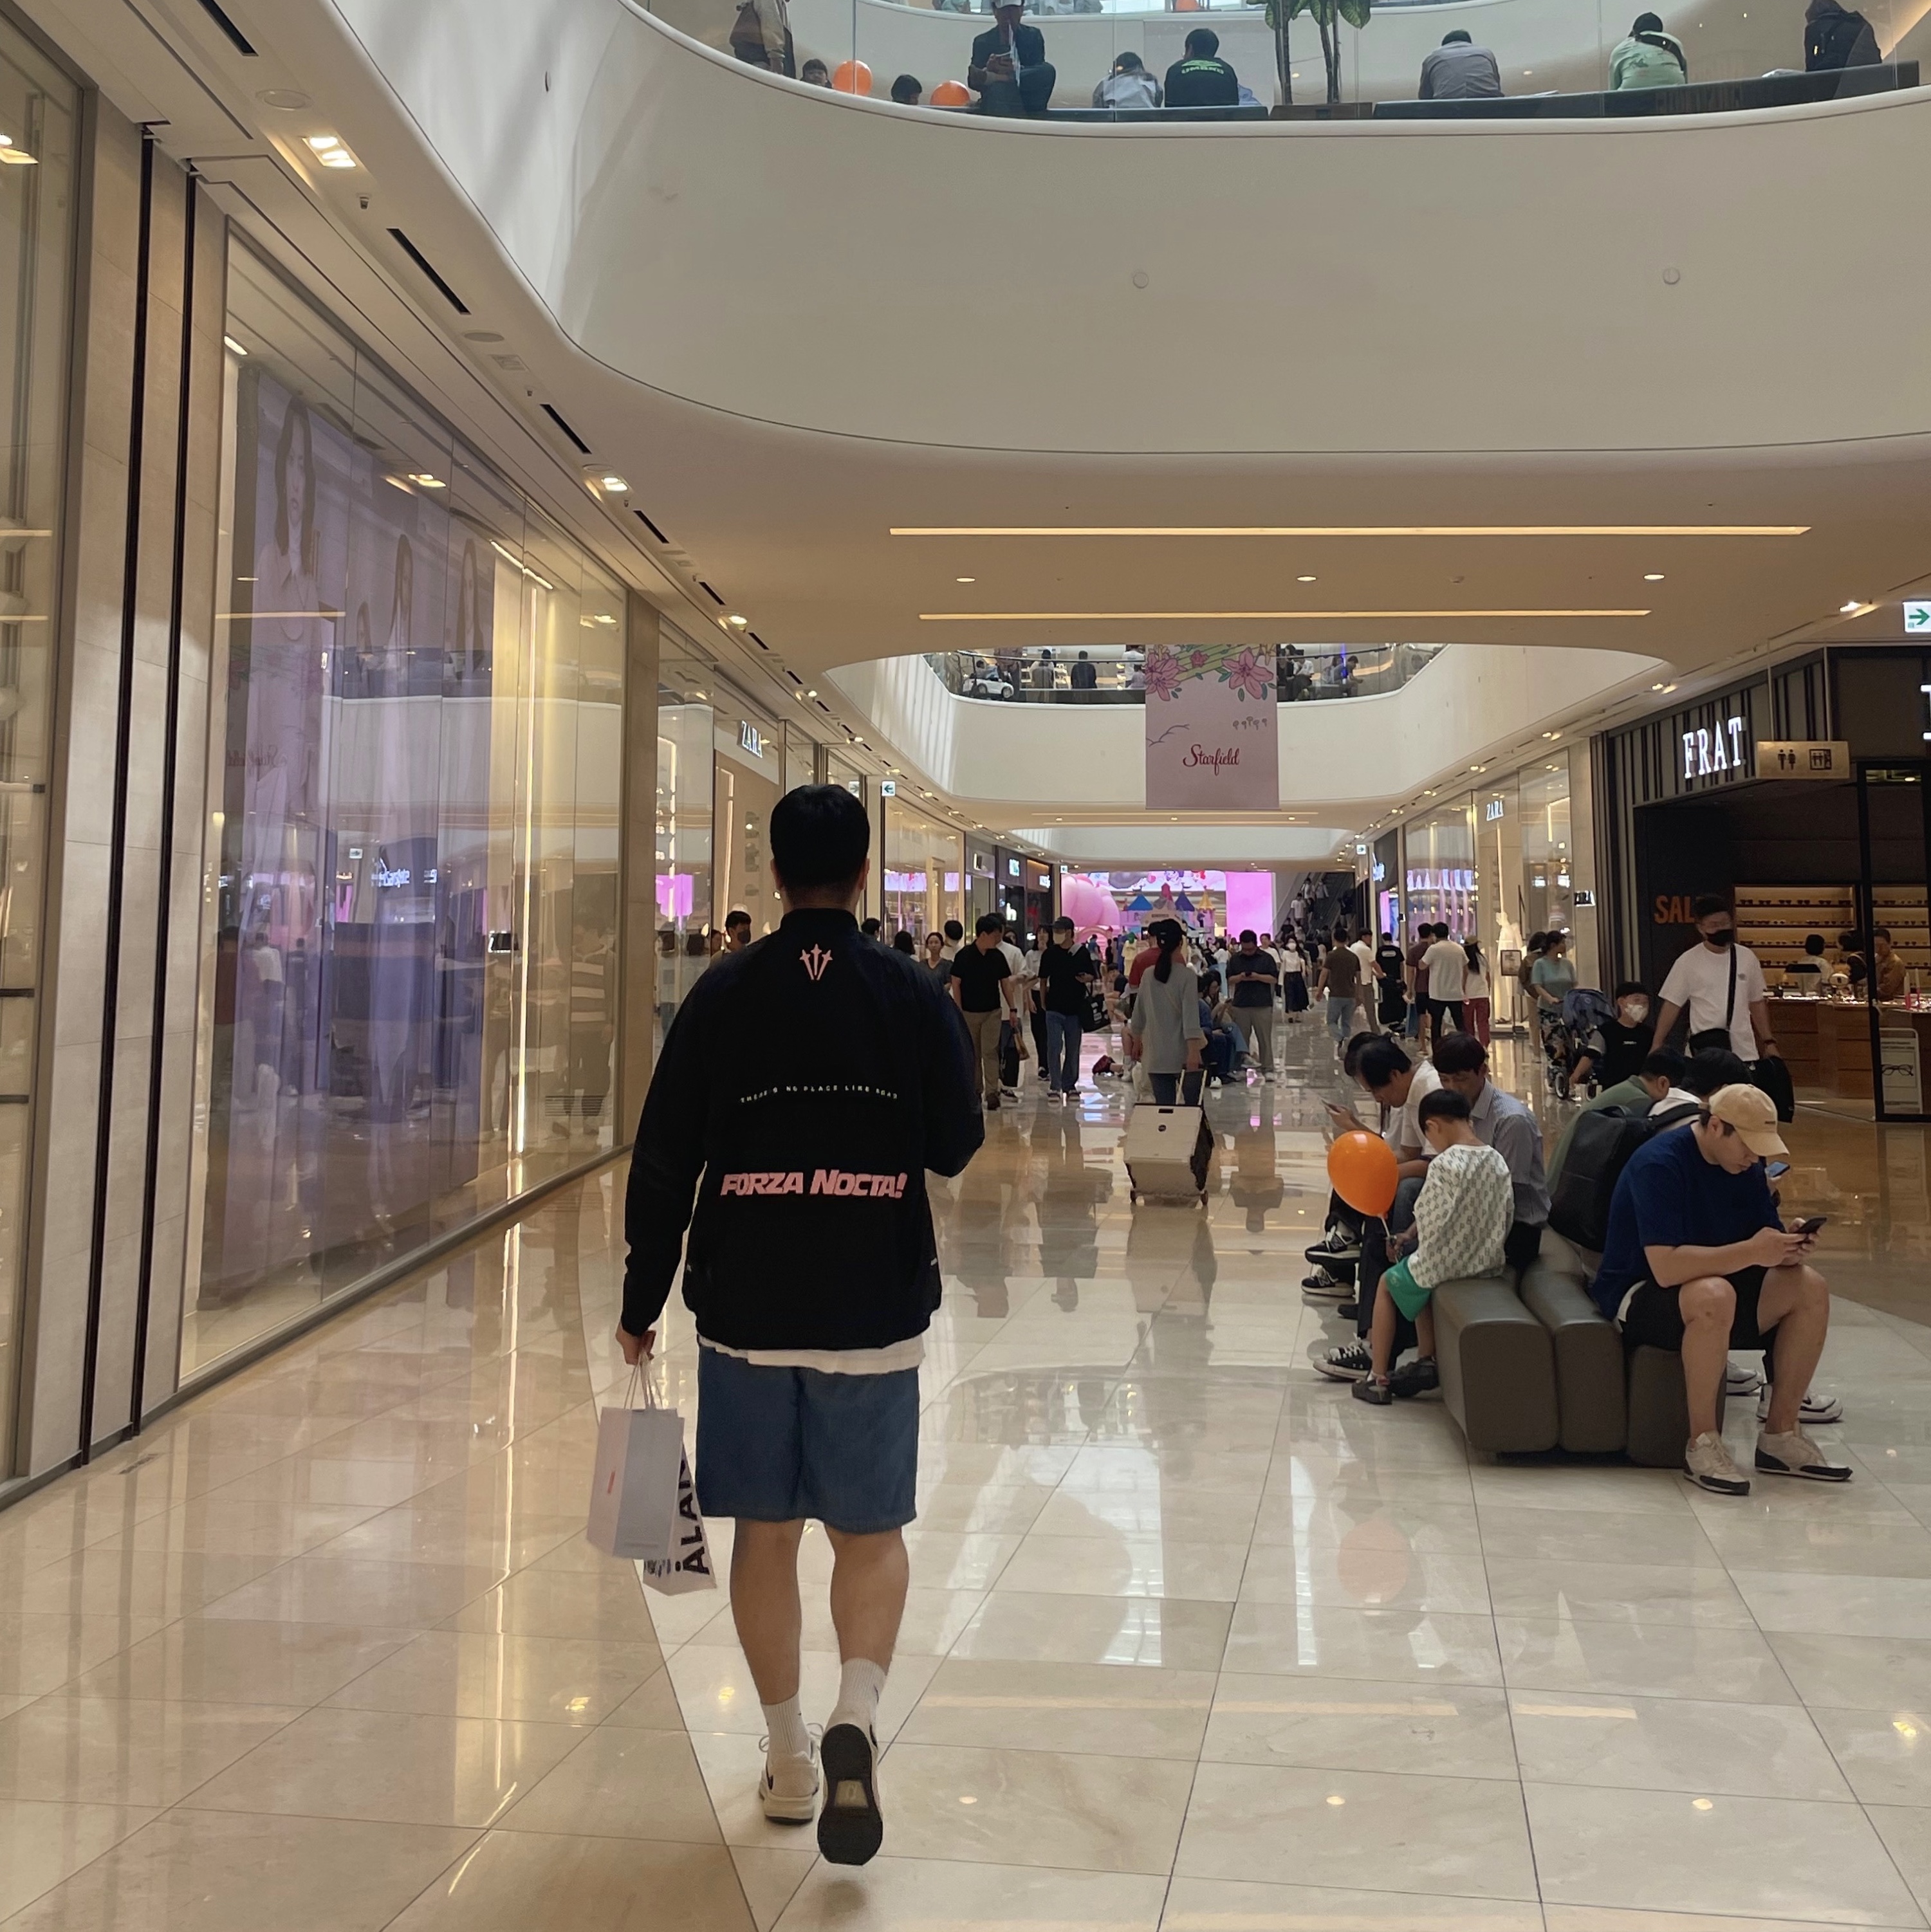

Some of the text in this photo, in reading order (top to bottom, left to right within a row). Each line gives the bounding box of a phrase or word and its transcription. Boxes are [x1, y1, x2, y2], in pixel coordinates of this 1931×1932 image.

[741, 720, 763, 759] ZARA
[1683, 716, 1742, 779] FRAT
[1183, 744, 1240, 777] Starfield
[720, 1172, 804, 1196] FORZA
